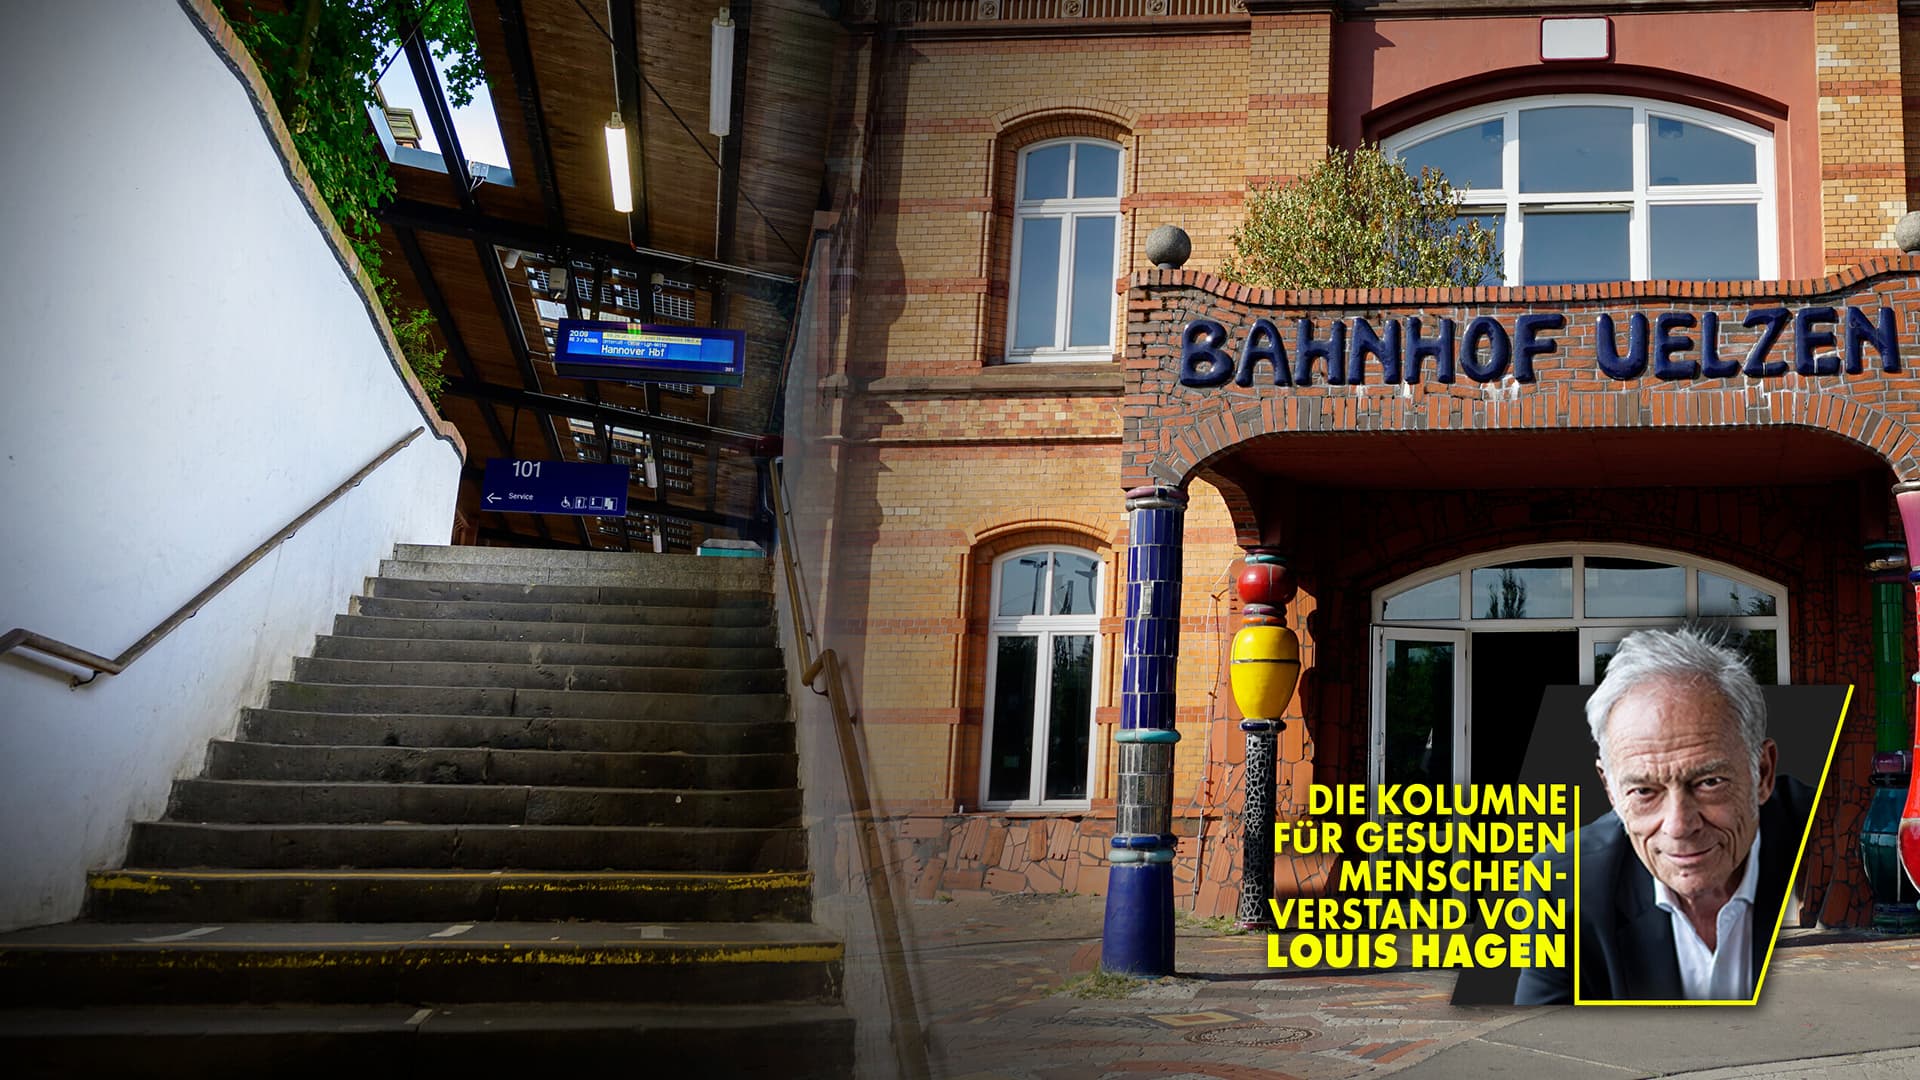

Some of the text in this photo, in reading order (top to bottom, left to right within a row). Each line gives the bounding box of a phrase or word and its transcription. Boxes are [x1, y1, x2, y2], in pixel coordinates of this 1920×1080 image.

[601, 344, 665, 357] Hannover Hbf
[1180, 306, 1902, 388] BAHNHOF UELZEN
[512, 460, 541, 478] 101
[508, 492, 534, 501] Service
